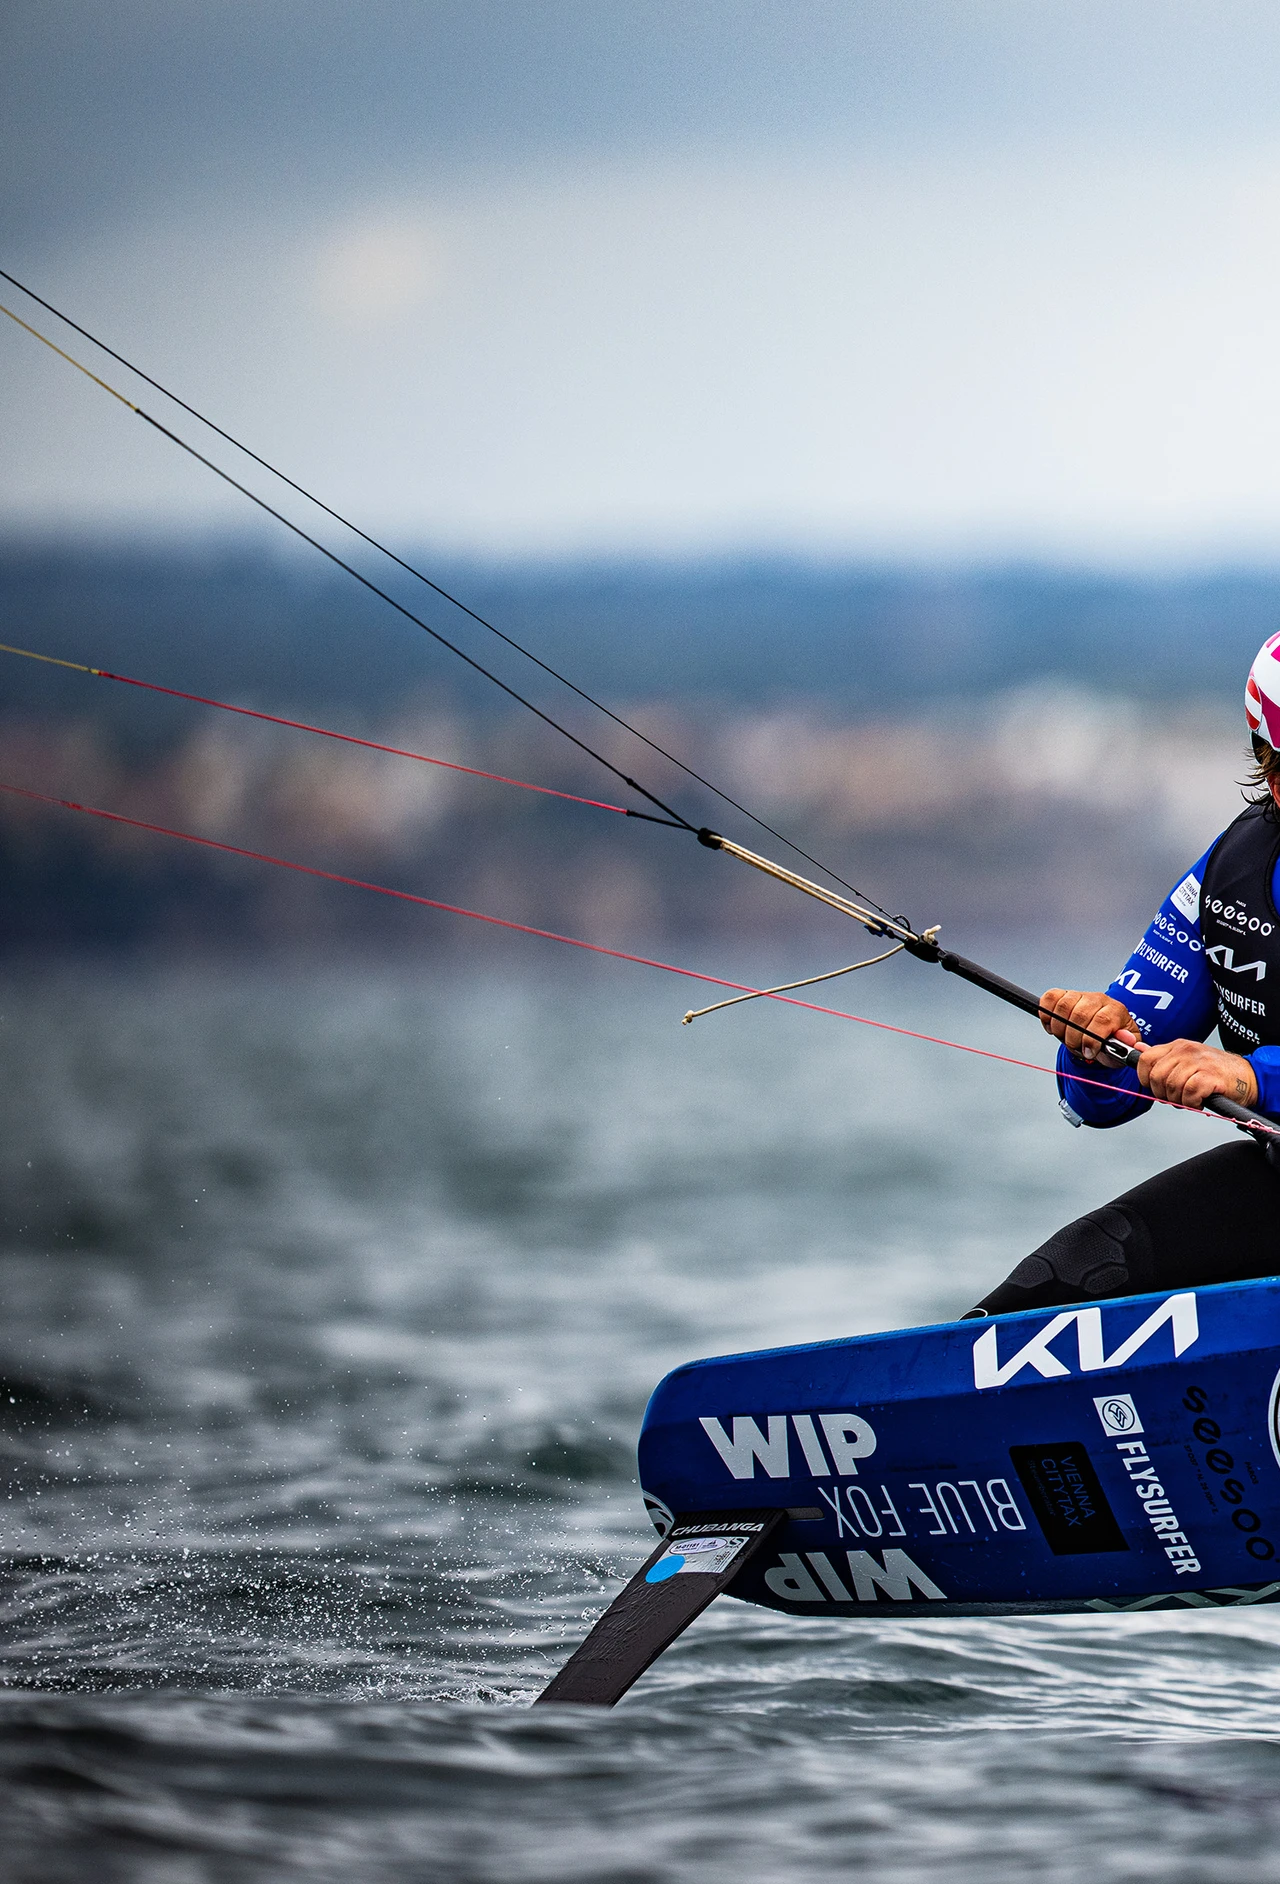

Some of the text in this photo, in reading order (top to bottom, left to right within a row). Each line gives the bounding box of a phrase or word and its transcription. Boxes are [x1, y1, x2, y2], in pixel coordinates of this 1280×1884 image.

[1137, 942, 1189, 984] FLYSURFER
[973, 1291, 1200, 1390] KIA
[698, 1413, 877, 1480] WIP
[817, 1478, 1027, 1539] BLUE FOX
[1041, 1458, 1083, 1527] CITYTAX
[1061, 1456, 1096, 1518] VIENNA
[1116, 1440, 1202, 1575] FLYSURFER
[671, 1522, 765, 1537] CHUBANGA
[764, 1548, 948, 1601] WIP
